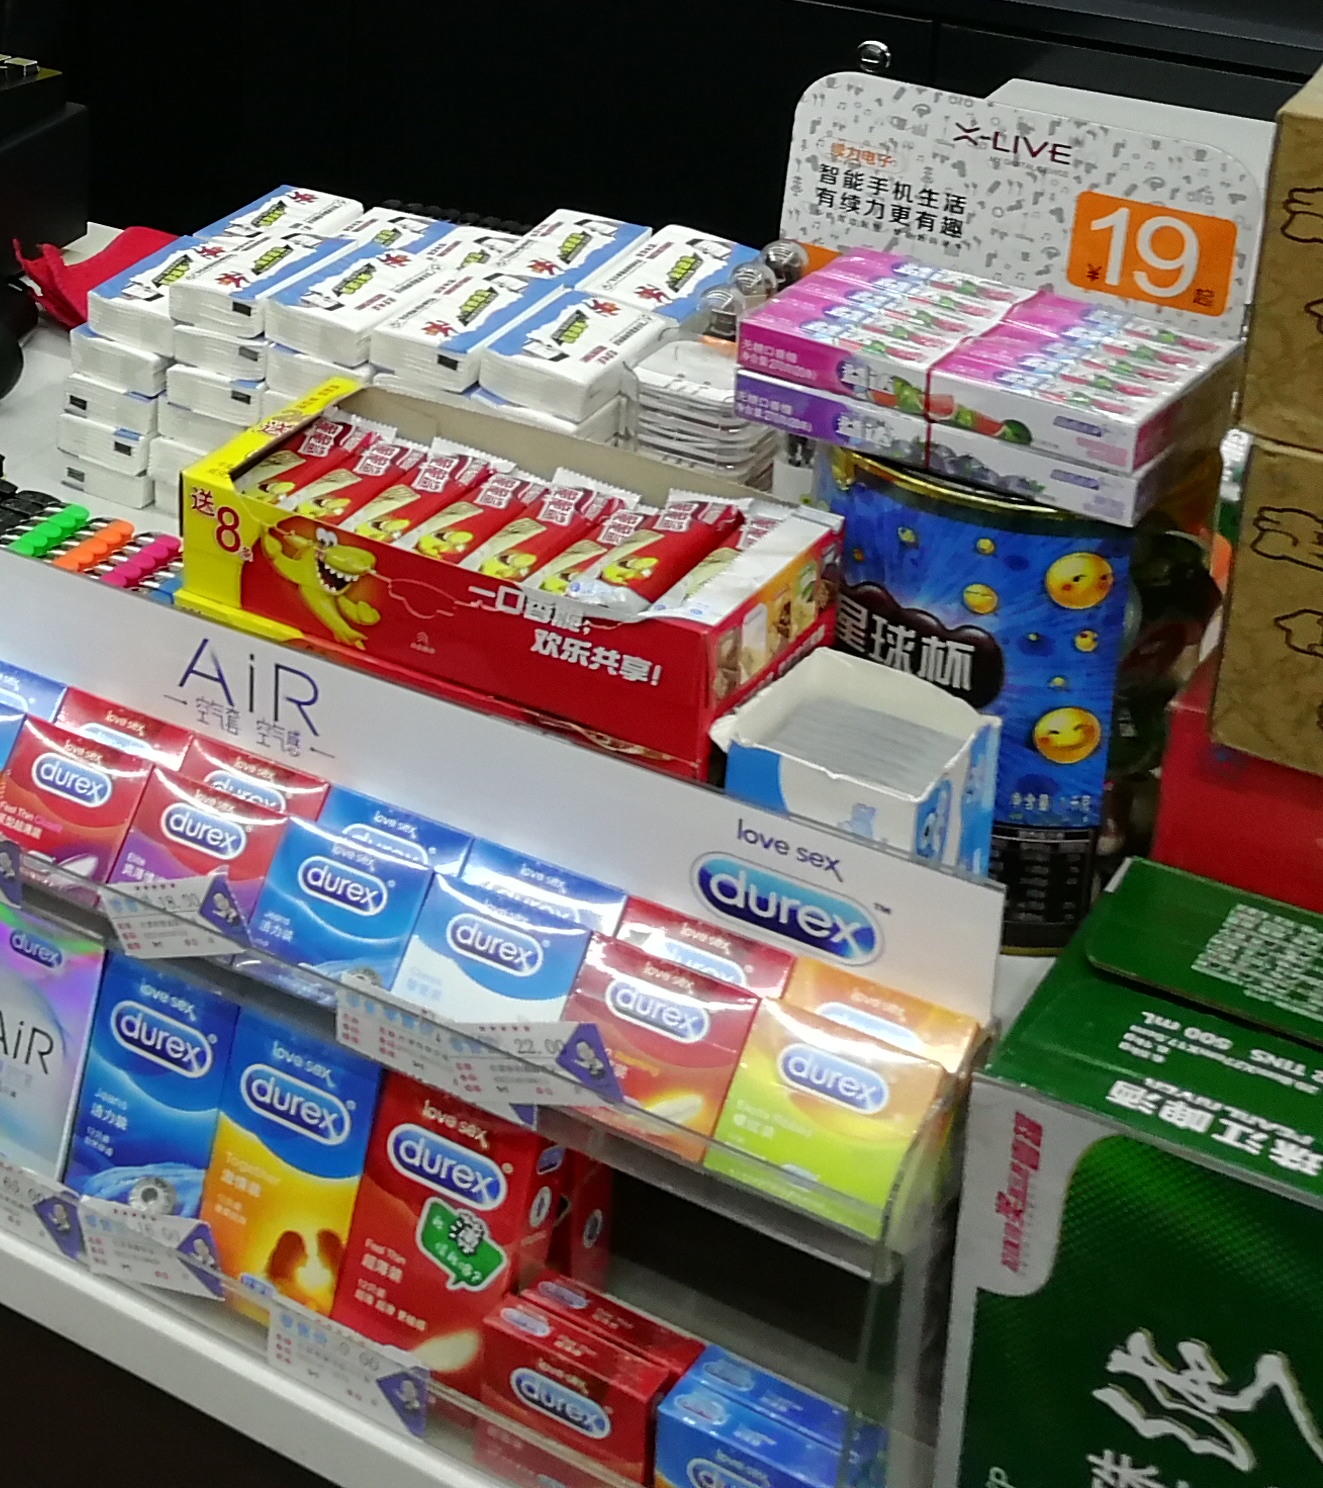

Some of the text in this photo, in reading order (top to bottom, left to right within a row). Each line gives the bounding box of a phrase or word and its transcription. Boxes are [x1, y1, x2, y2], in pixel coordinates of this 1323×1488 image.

[952, 123, 1073, 166] X-LIVE
[817, 164, 968, 212] 智能手机生活
[815, 187, 964, 238] 有续力更有趣
[1089, 206, 1200, 298] 19
[190, 486, 216, 517] 送
[215, 506, 240, 552] 8
[531, 628, 664, 688] 欢乐共享!
[38, 761, 102, 803] durex
[168, 811, 236, 852] durex
[736, 819, 843, 882] love sex
[305, 863, 381, 914] durex
[708, 867, 875, 960] durex
[456, 922, 536, 967] durex
[139, 982, 171, 1010] love
[615, 989, 702, 1034] durex
[118, 1010, 207, 1072] durex
[273, 1040, 301, 1069] love
[1183, 1026, 1233, 1051] 500
[785, 1049, 881, 1105] durex
[248, 1075, 343, 1139] durex
[422, 1100, 453, 1130] love
[399, 1138, 496, 1204] durex
